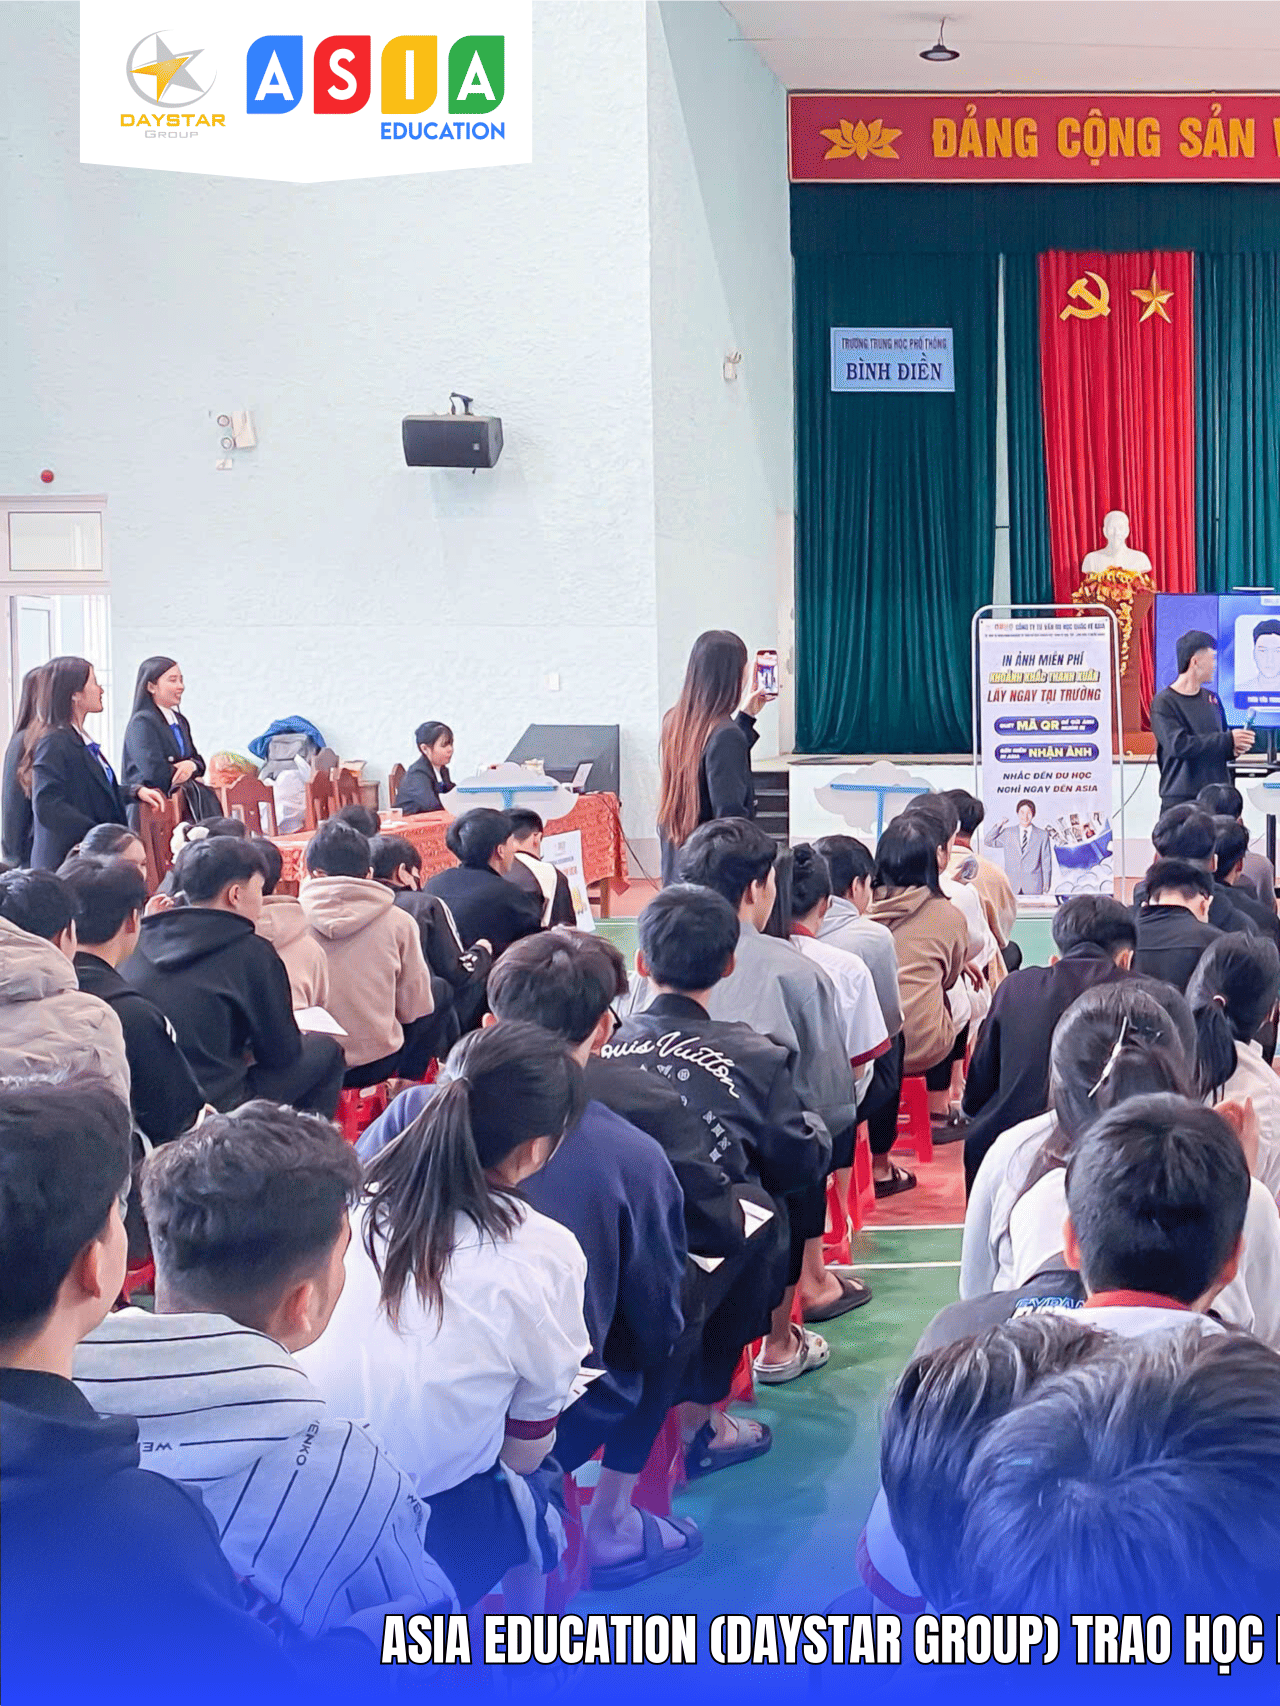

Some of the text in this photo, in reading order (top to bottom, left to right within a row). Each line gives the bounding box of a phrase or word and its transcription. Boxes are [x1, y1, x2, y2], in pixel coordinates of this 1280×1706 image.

[932, 103, 1039, 159] ĐẢNG
[1057, 109, 1161, 165] CỘNG
[1179, 104, 1255, 158] SẢN
[870, 338, 892, 350] TRUNG
[925, 336, 947, 350] THÔNG
[846, 352, 942, 380] BÌNH ĐIỀN
[1002, 654, 1012, 666] IN
[1015, 651, 1036, 666] ẢNH
[1067, 651, 1085, 665] PHÍ
[987, 685, 1101, 704] LẤY NGAY TẠI TRƯỜNG
[1040, 720, 1059, 731] QR
[1028, 745, 1063, 760] NHẬN
[1066, 745, 1092, 758] ẢNH
[1003, 770, 1031, 780] NHẮC
[1071, 771, 1092, 780] HỌC
[656, 1031, 740, 1098] Vuitton
